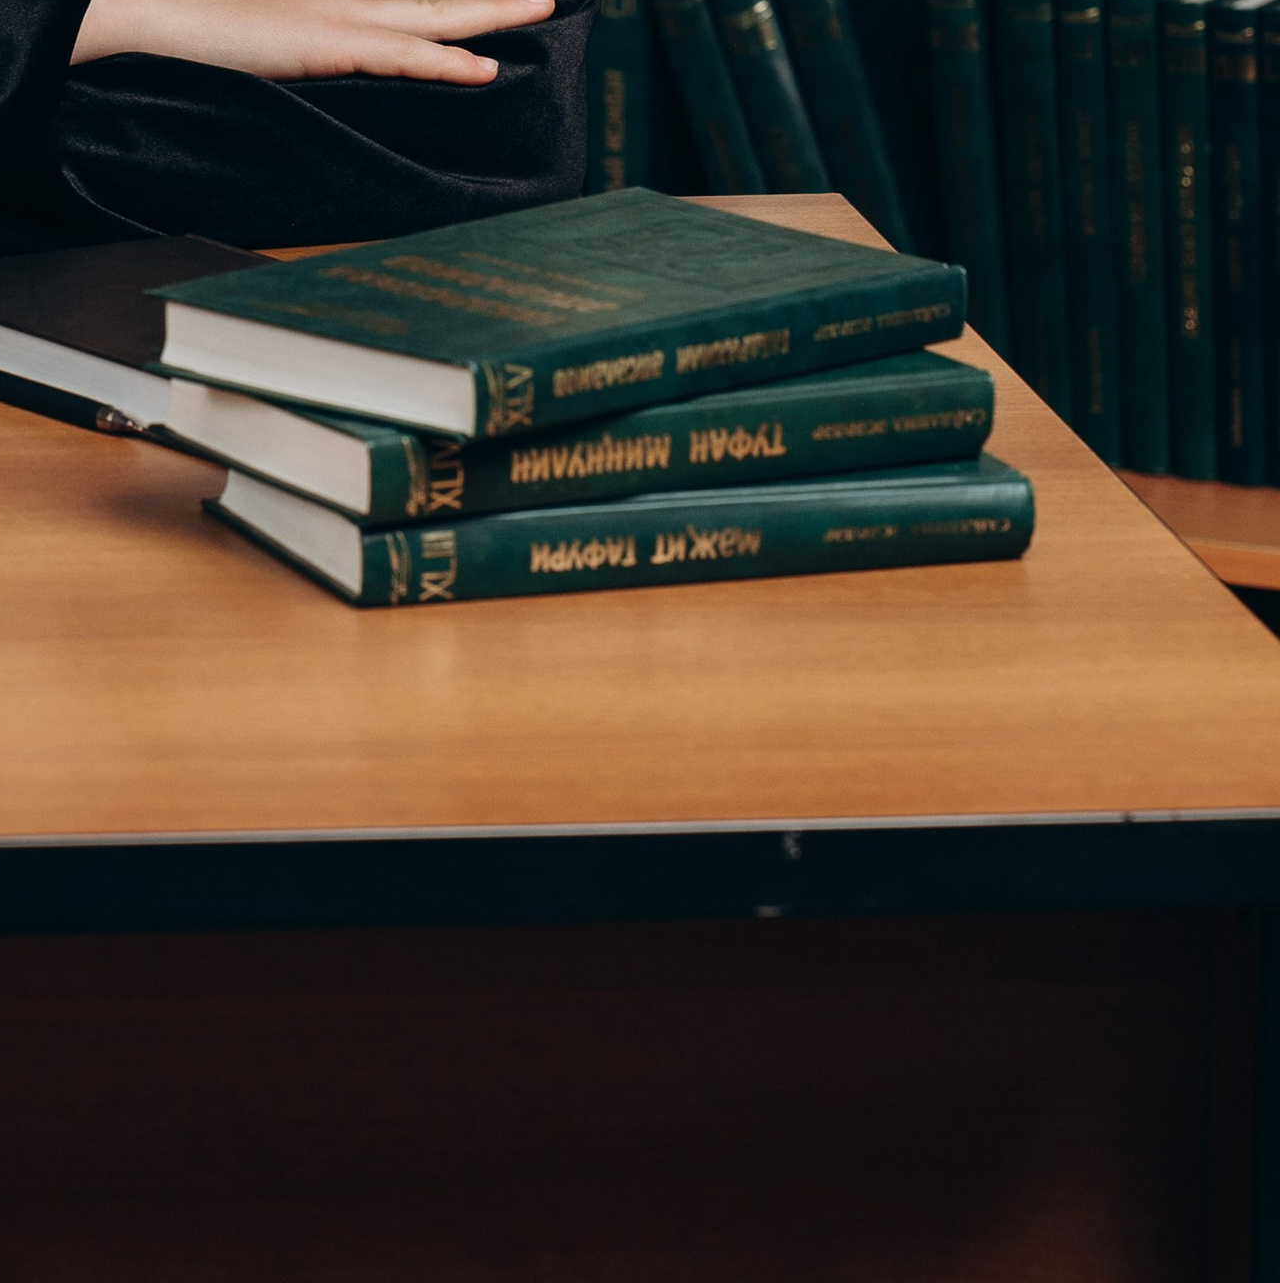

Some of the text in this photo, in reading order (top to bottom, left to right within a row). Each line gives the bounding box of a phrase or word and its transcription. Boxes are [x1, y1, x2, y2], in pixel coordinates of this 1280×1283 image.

[689, 422, 788, 465] ТУФАН
[528, 523, 762, 574] МӘҖИТ ГАФУРИ
